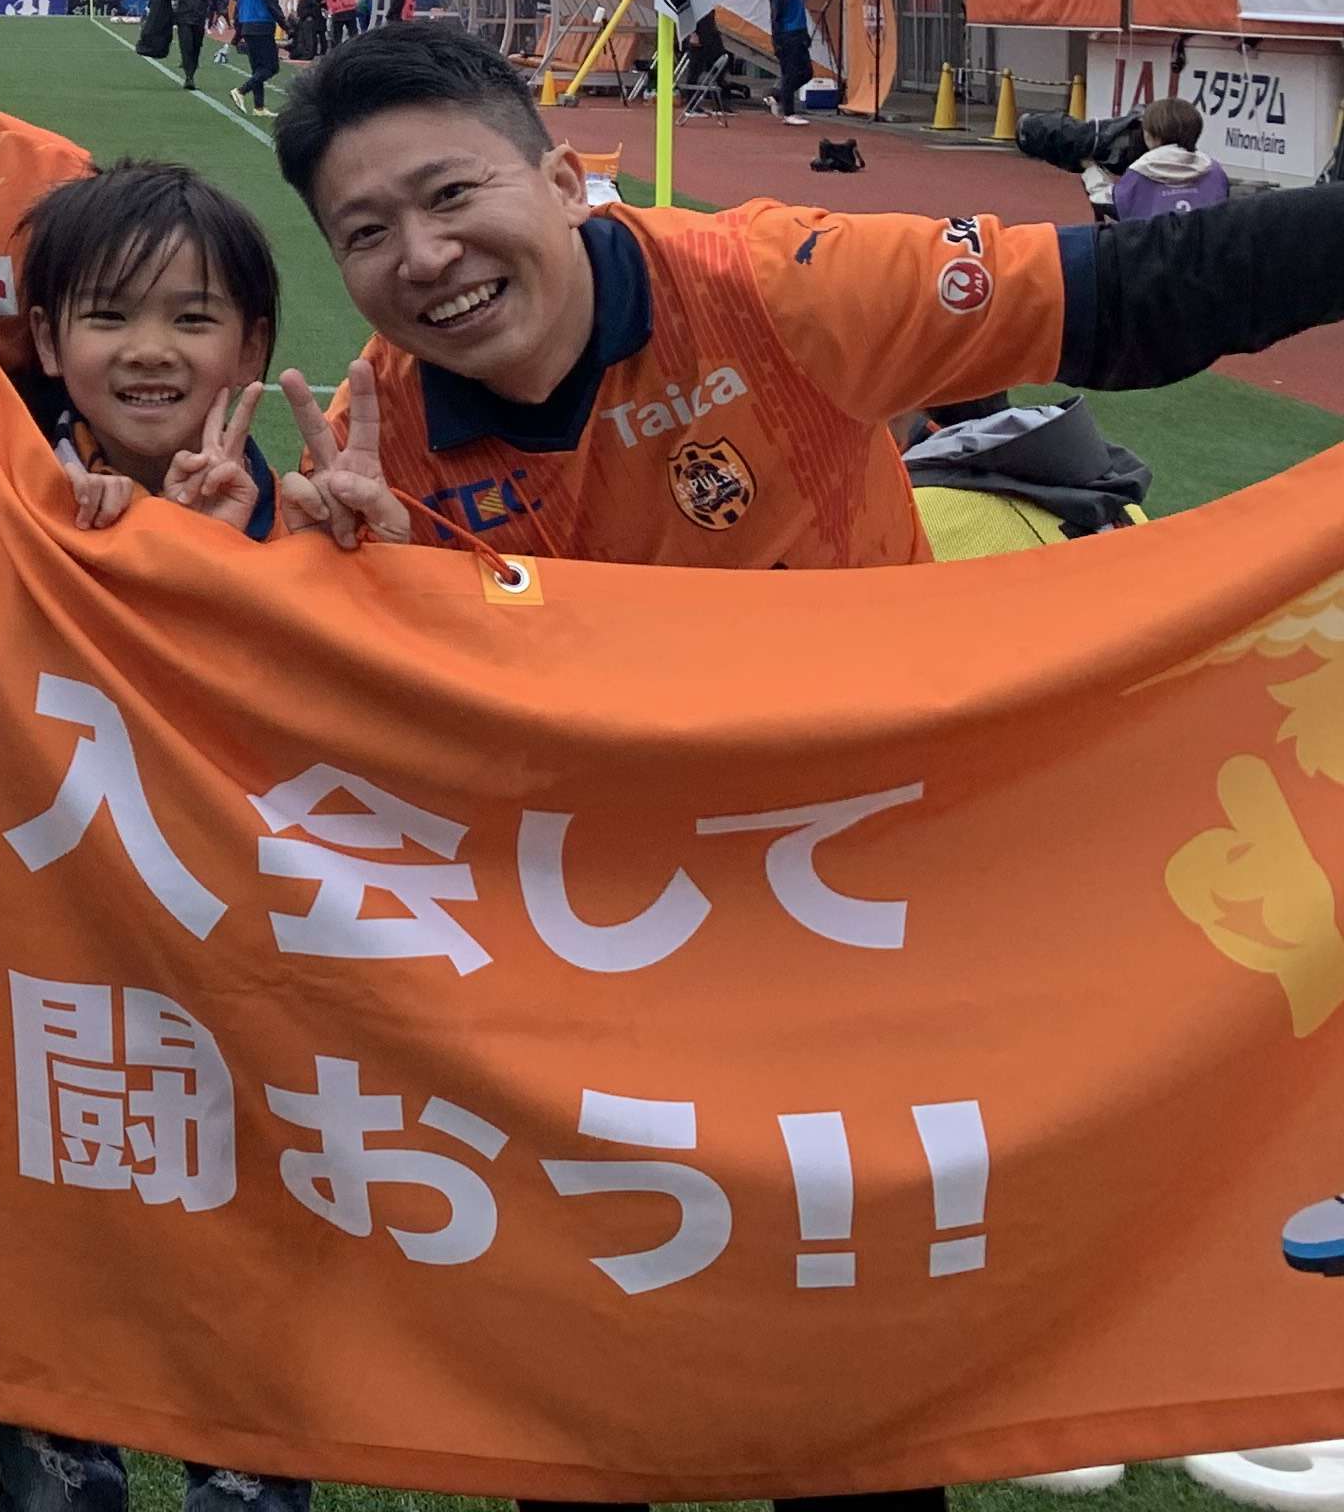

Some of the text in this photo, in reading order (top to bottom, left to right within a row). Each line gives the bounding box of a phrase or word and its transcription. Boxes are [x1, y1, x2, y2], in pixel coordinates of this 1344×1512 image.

[1191, 69, 1286, 125] スタジアム
[1224, 127, 1286, 155] Nihondaira
[973, 272, 985, 297] JAL
[601, 365, 749, 450] Taica
